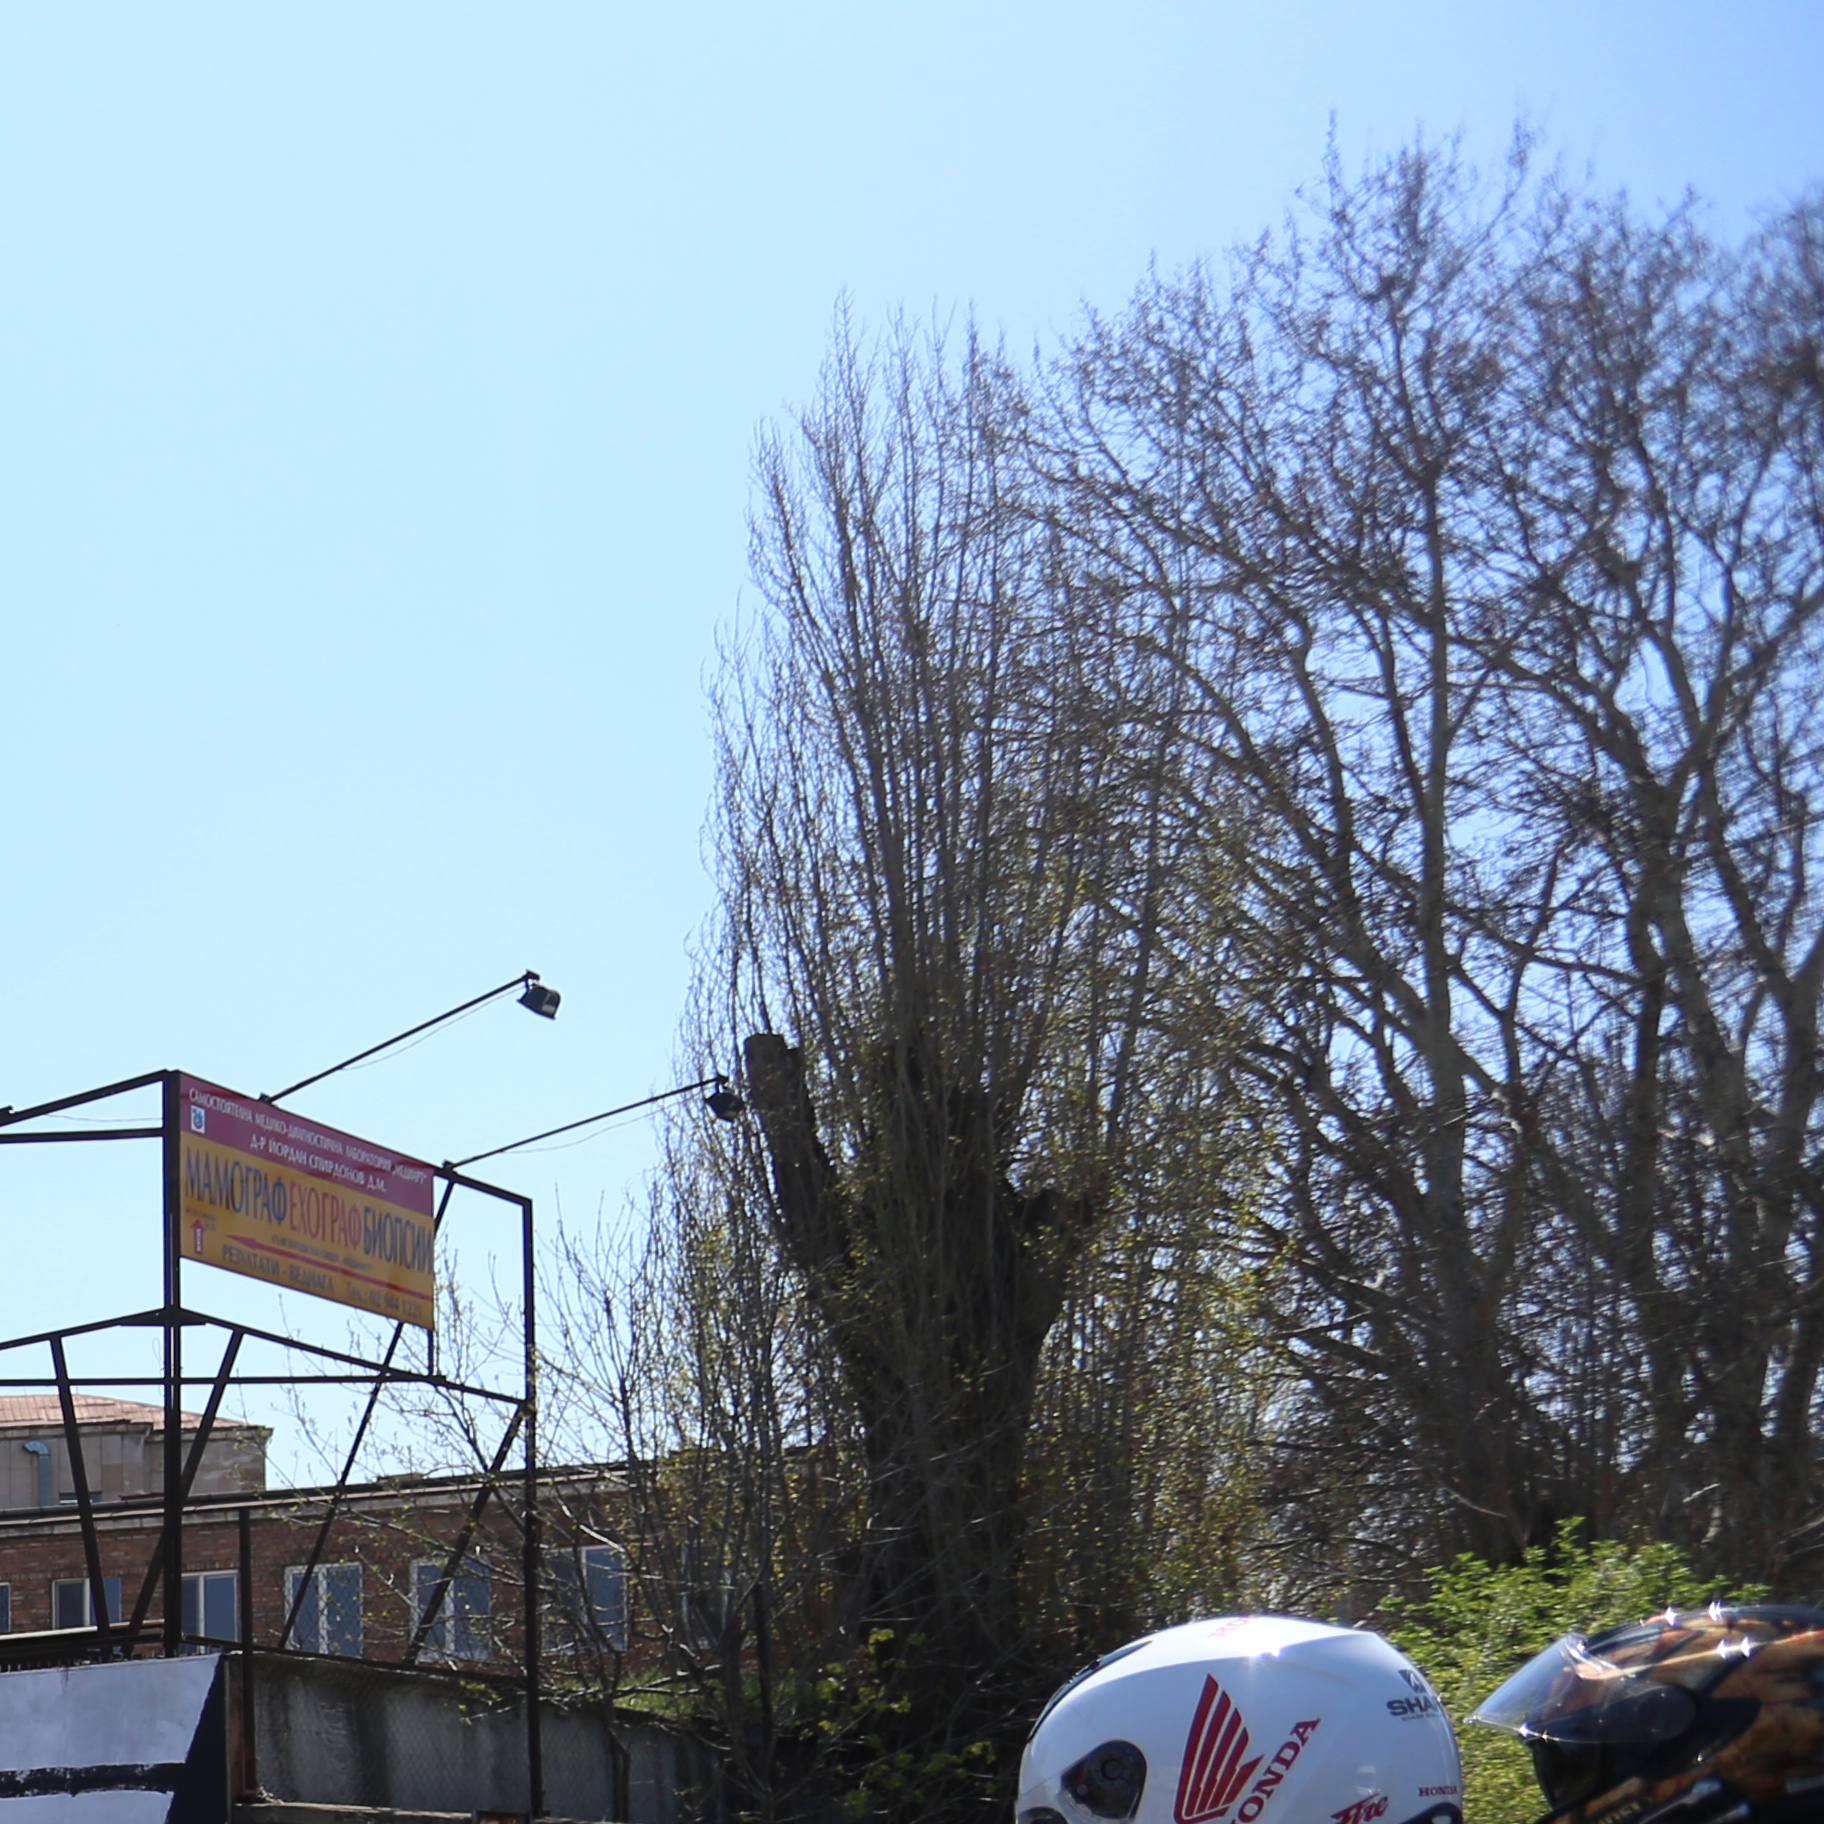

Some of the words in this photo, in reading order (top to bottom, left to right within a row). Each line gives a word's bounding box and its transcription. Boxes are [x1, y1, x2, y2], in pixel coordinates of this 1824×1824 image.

[269, 1137, 307, 1166] ЙОРДАН
[185, 1145, 288, 1228] МАМОГРАФ
[289, 1179, 363, 1252] ЕХОГРАФ
[1418, 1785, 1459, 1797] HONDA
